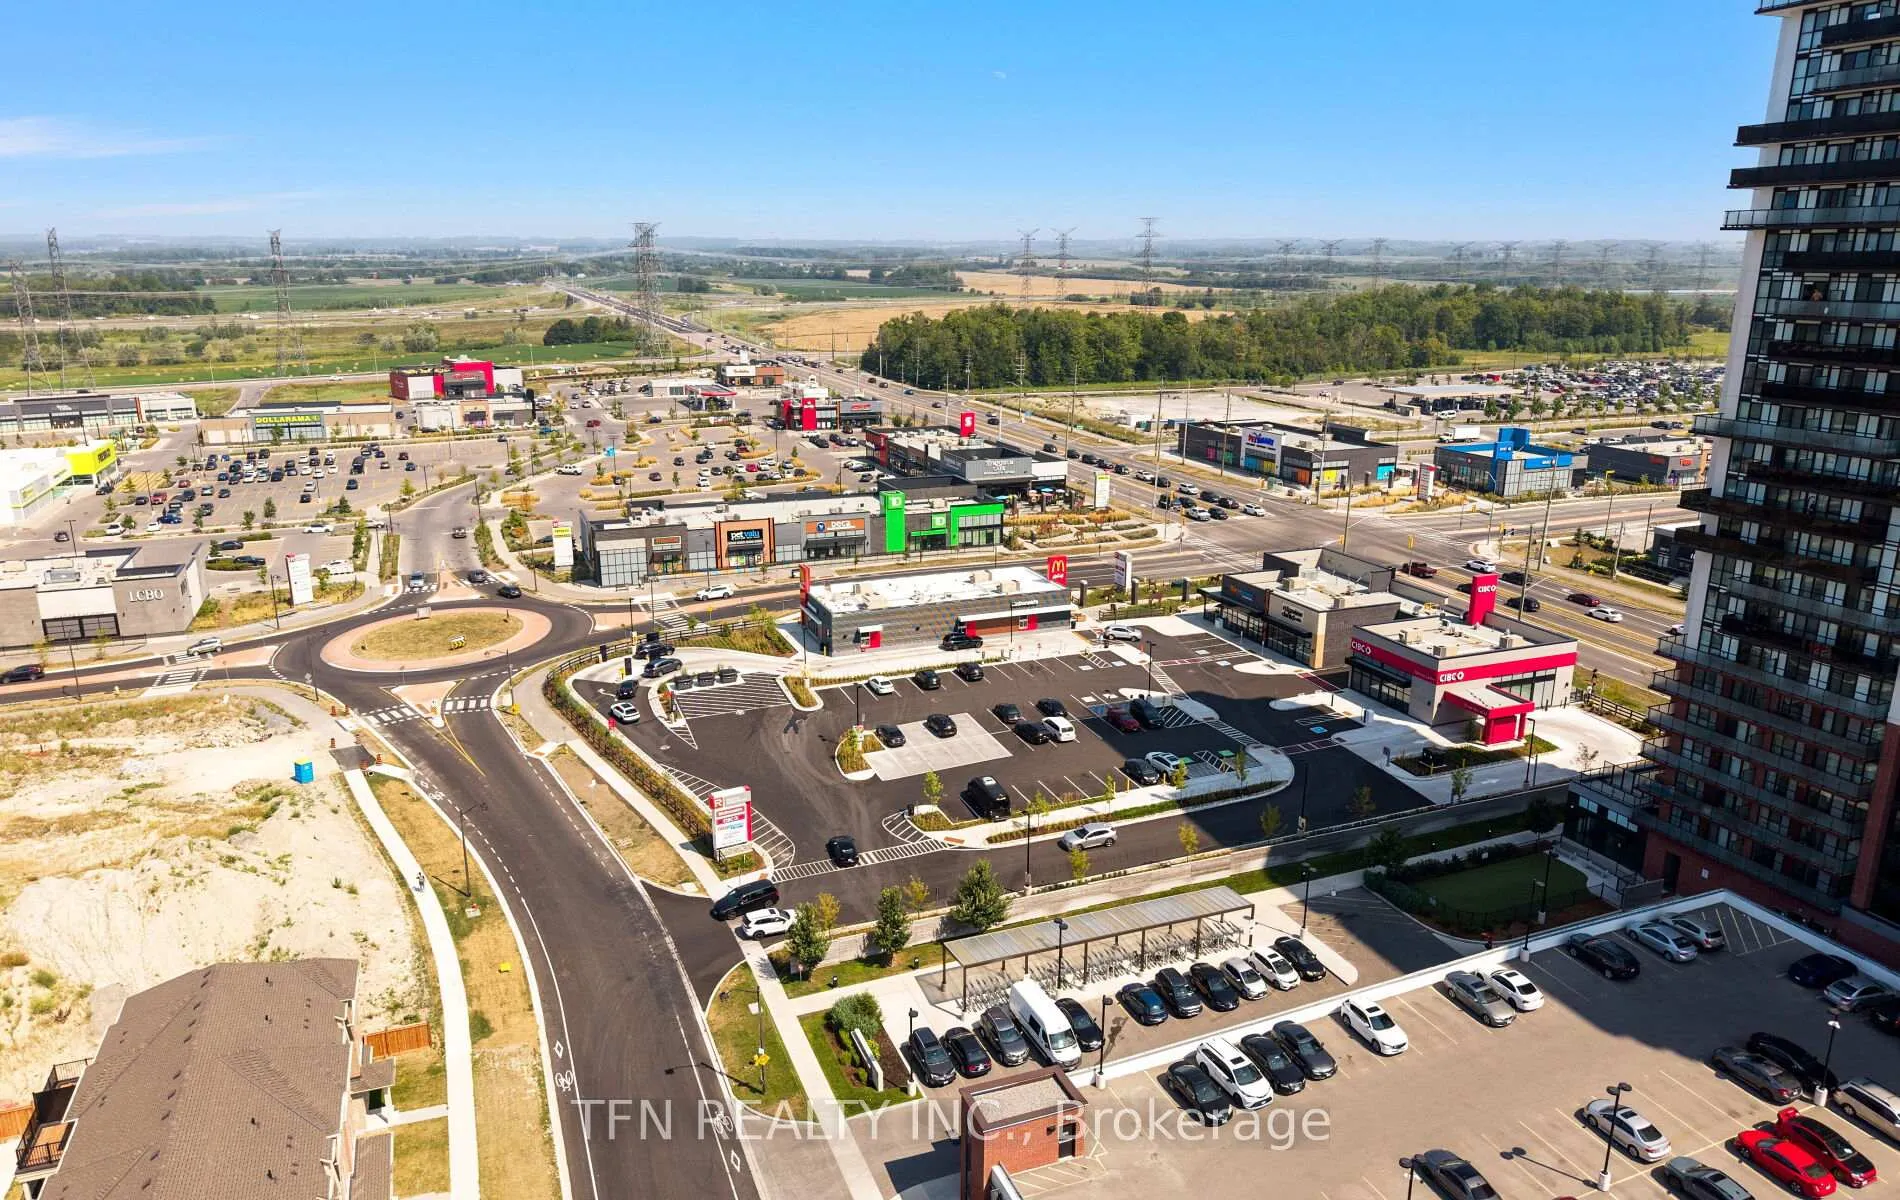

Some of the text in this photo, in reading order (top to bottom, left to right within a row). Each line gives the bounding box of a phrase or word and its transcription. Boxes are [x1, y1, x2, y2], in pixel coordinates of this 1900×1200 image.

[255, 415, 311, 424] DOLLARAMA
[730, 531, 744, 541] pet
[128, 588, 165, 603] LCBO
[1439, 673, 1457, 683] CIBC
